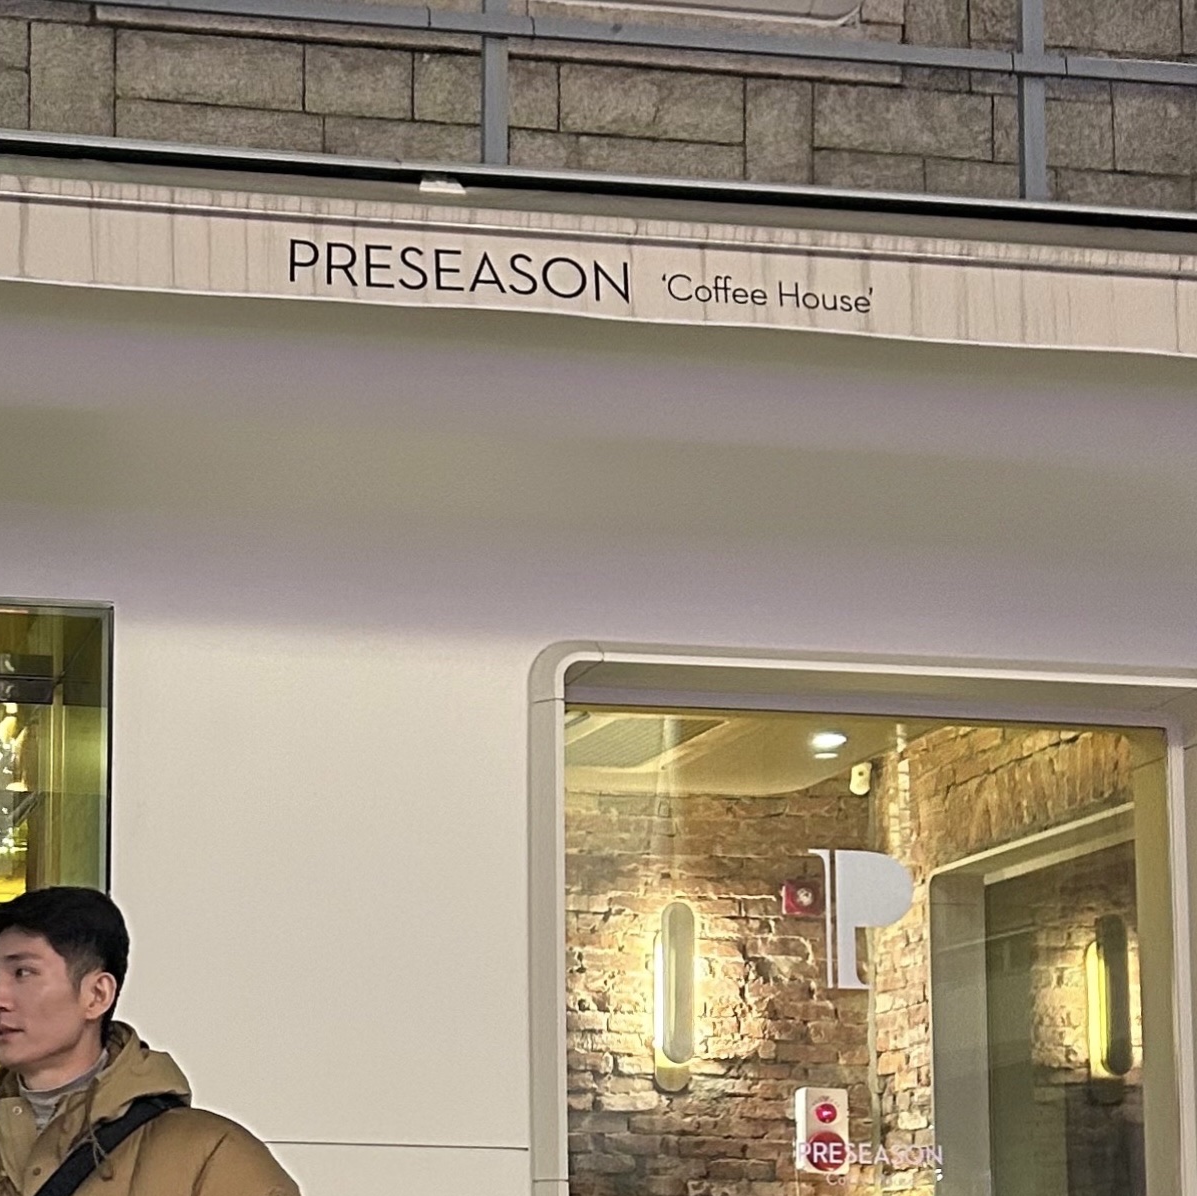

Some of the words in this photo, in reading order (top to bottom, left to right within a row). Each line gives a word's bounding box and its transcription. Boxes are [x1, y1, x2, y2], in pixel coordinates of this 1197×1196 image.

[287, 239, 632, 304] PRESEASON
[662, 273, 768, 306] 'Coffee
[779, 282, 874, 314] House'
[797, 1141, 944, 1166] PRESEASON
